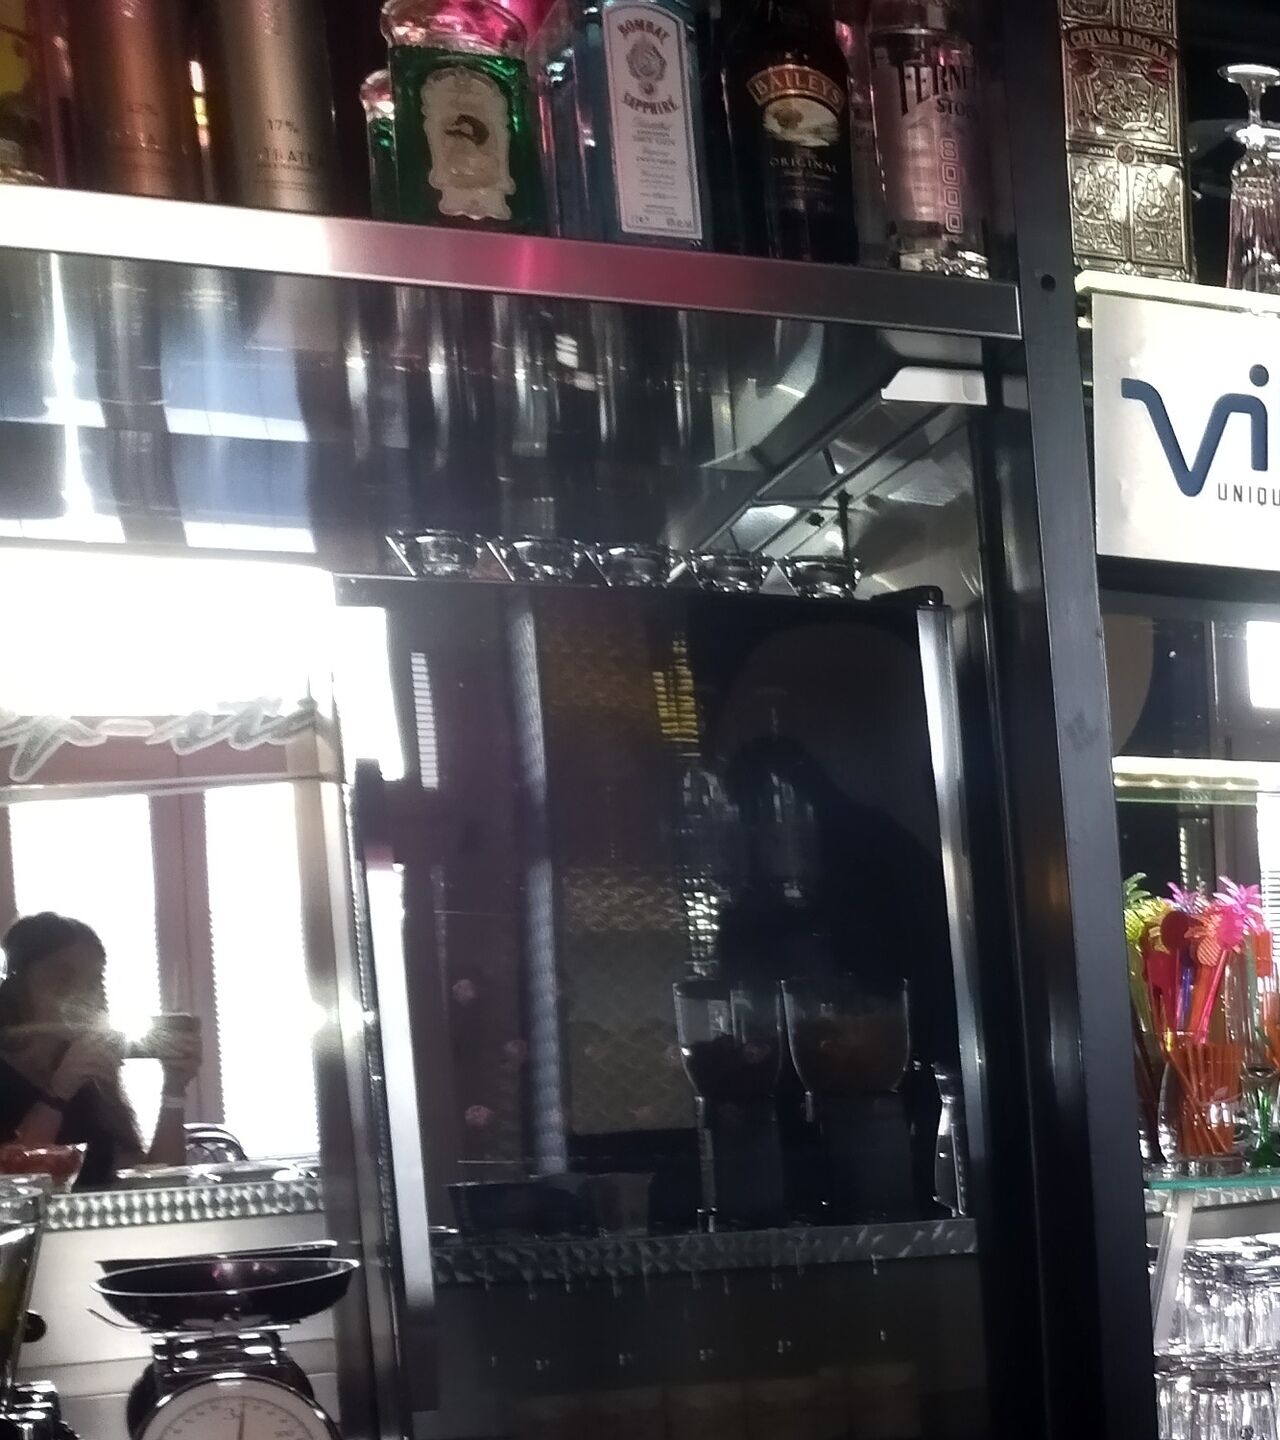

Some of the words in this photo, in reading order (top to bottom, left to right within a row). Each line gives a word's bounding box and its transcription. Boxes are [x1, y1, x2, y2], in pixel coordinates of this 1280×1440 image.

[617, 19, 671, 45] BOMBAY
[1069, 28, 1120, 47] CHIVAS
[1122, 31, 1168, 57] REGAL
[753, 69, 843, 103] BAILEYS
[623, 91, 679, 115] SAPPHIRE
[768, 157, 839, 174] ORIGINAL
